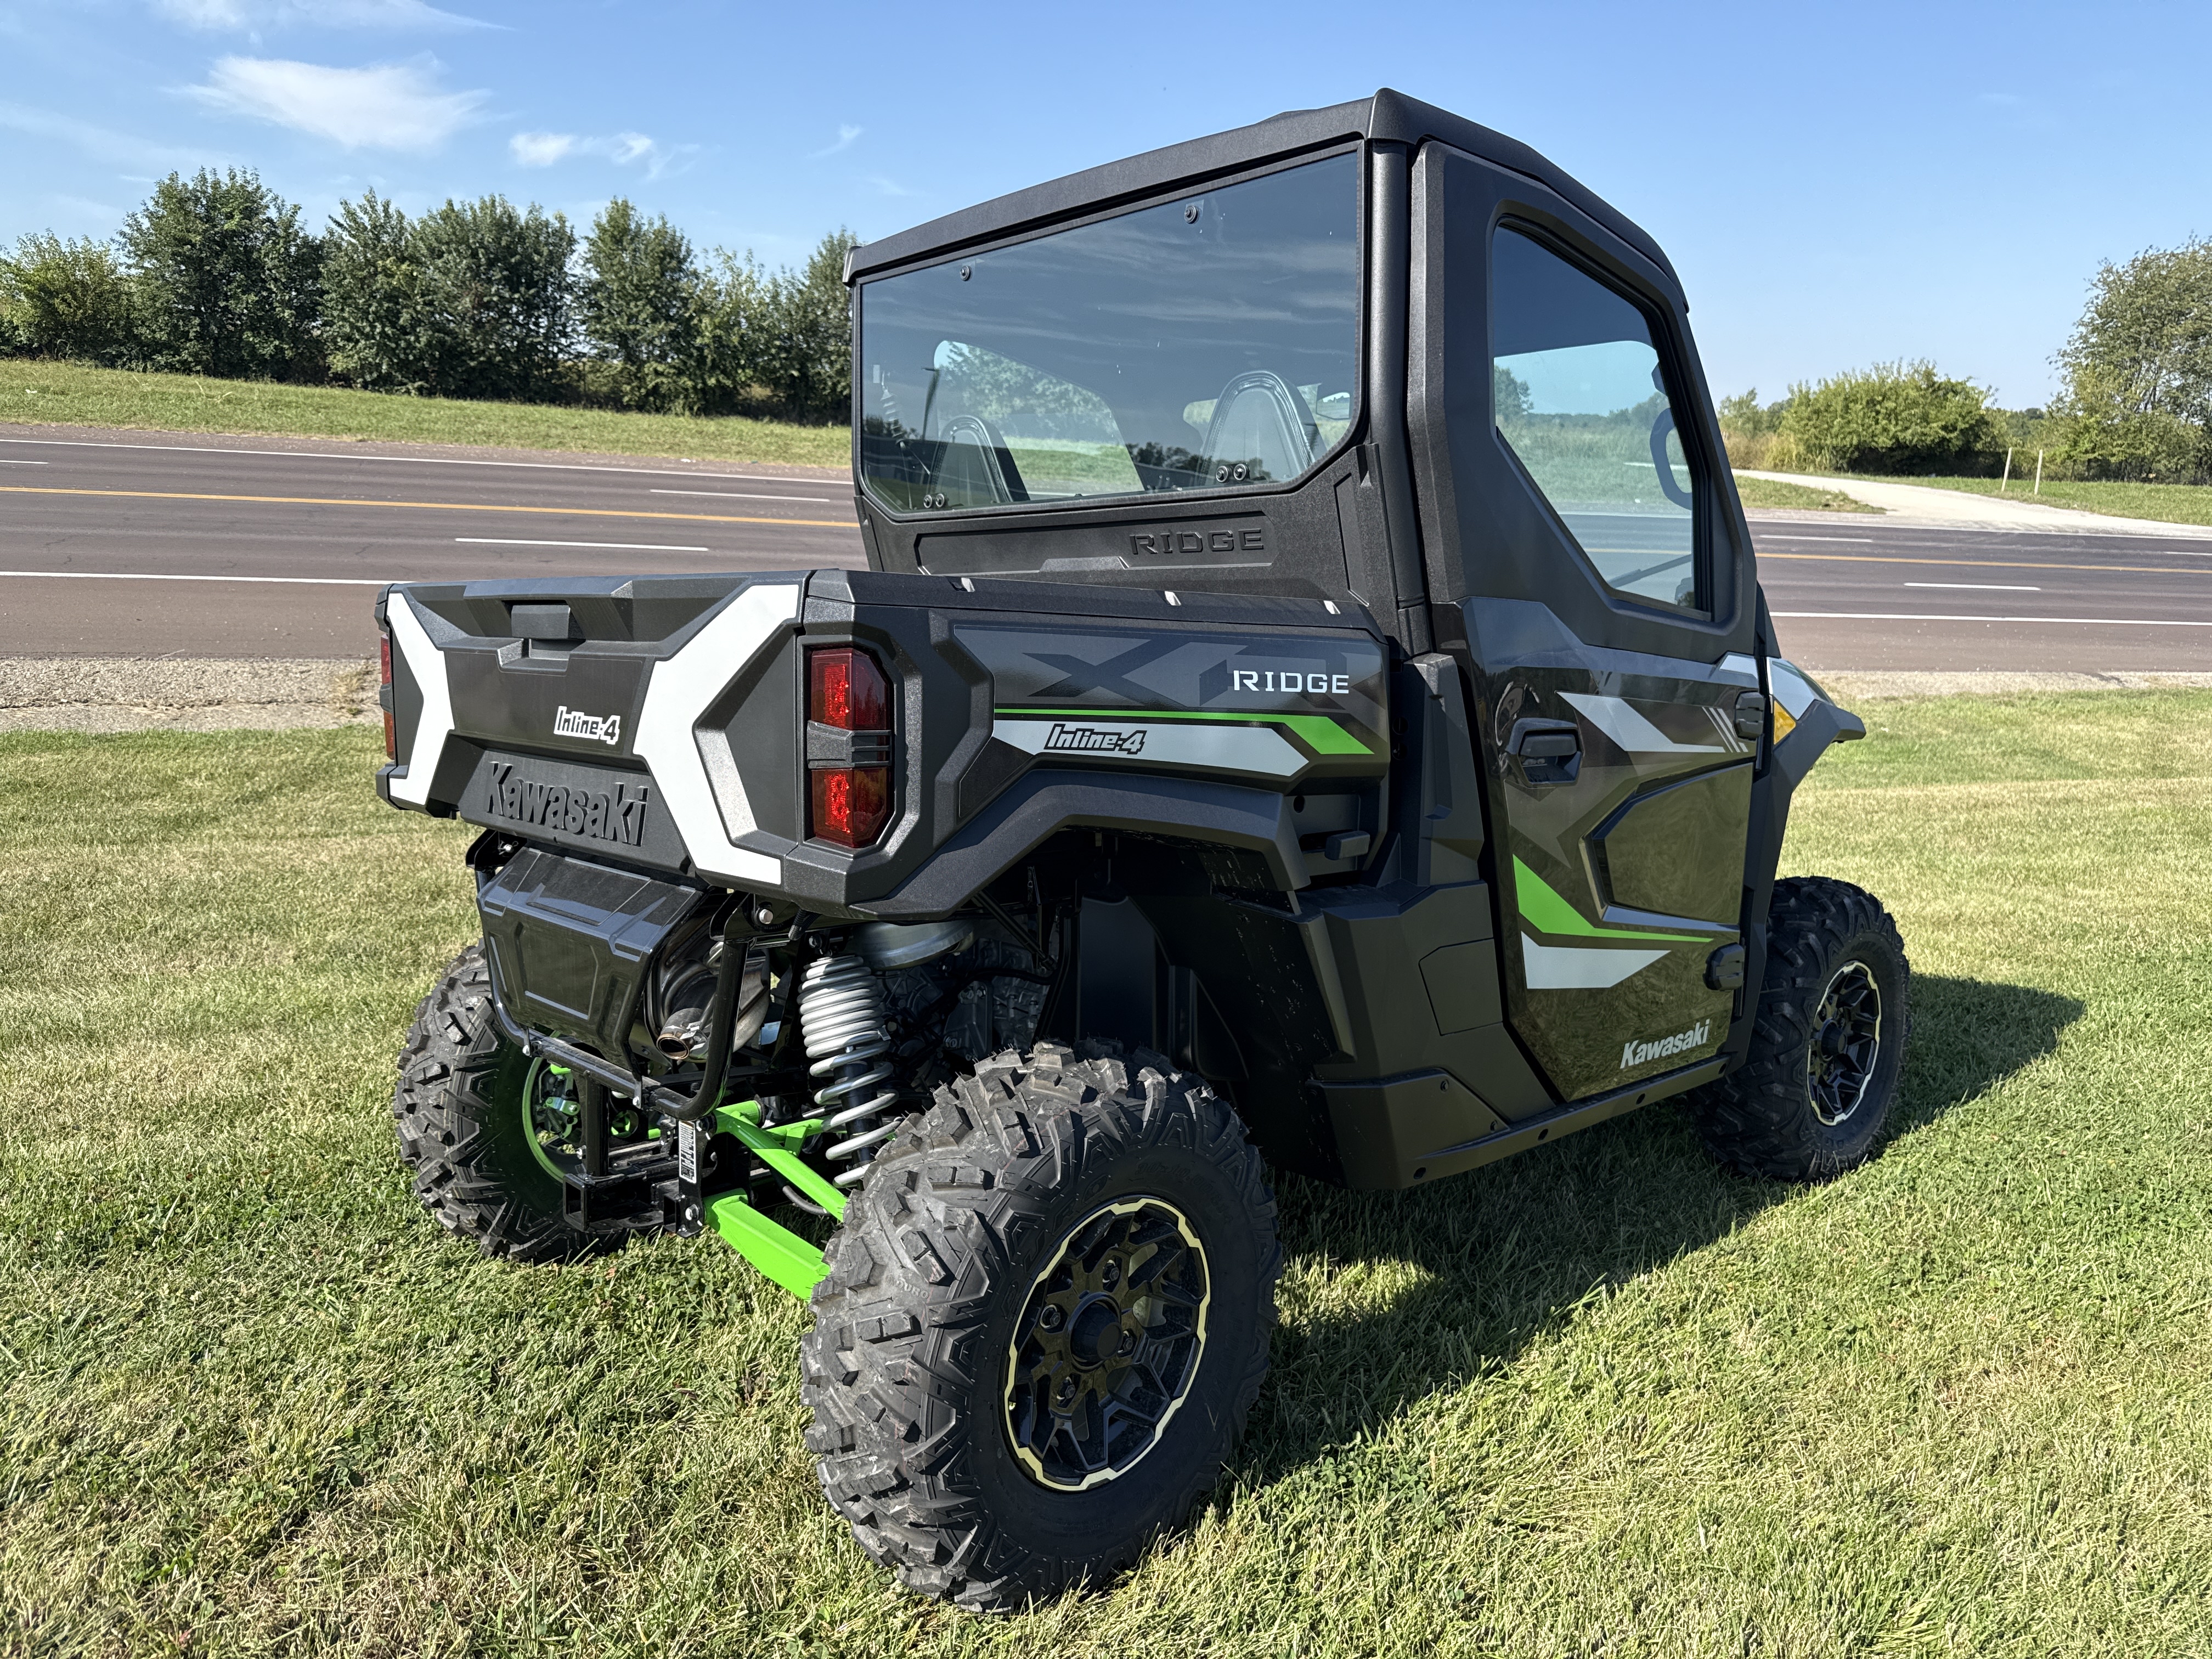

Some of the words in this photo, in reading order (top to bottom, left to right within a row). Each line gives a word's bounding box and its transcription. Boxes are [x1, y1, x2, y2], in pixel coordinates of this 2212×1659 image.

[1129, 528, 1264, 555] RIDGE
[1233, 670, 1349, 693] RIDGE
[555, 707, 619, 743] Inline-4
[1045, 724, 1146, 754] Inline-4
[487, 761, 648, 847] Kawasaki
[1620, 1018, 1710, 1069] Kawasaki
[895, 1278, 930, 1299] DURO
